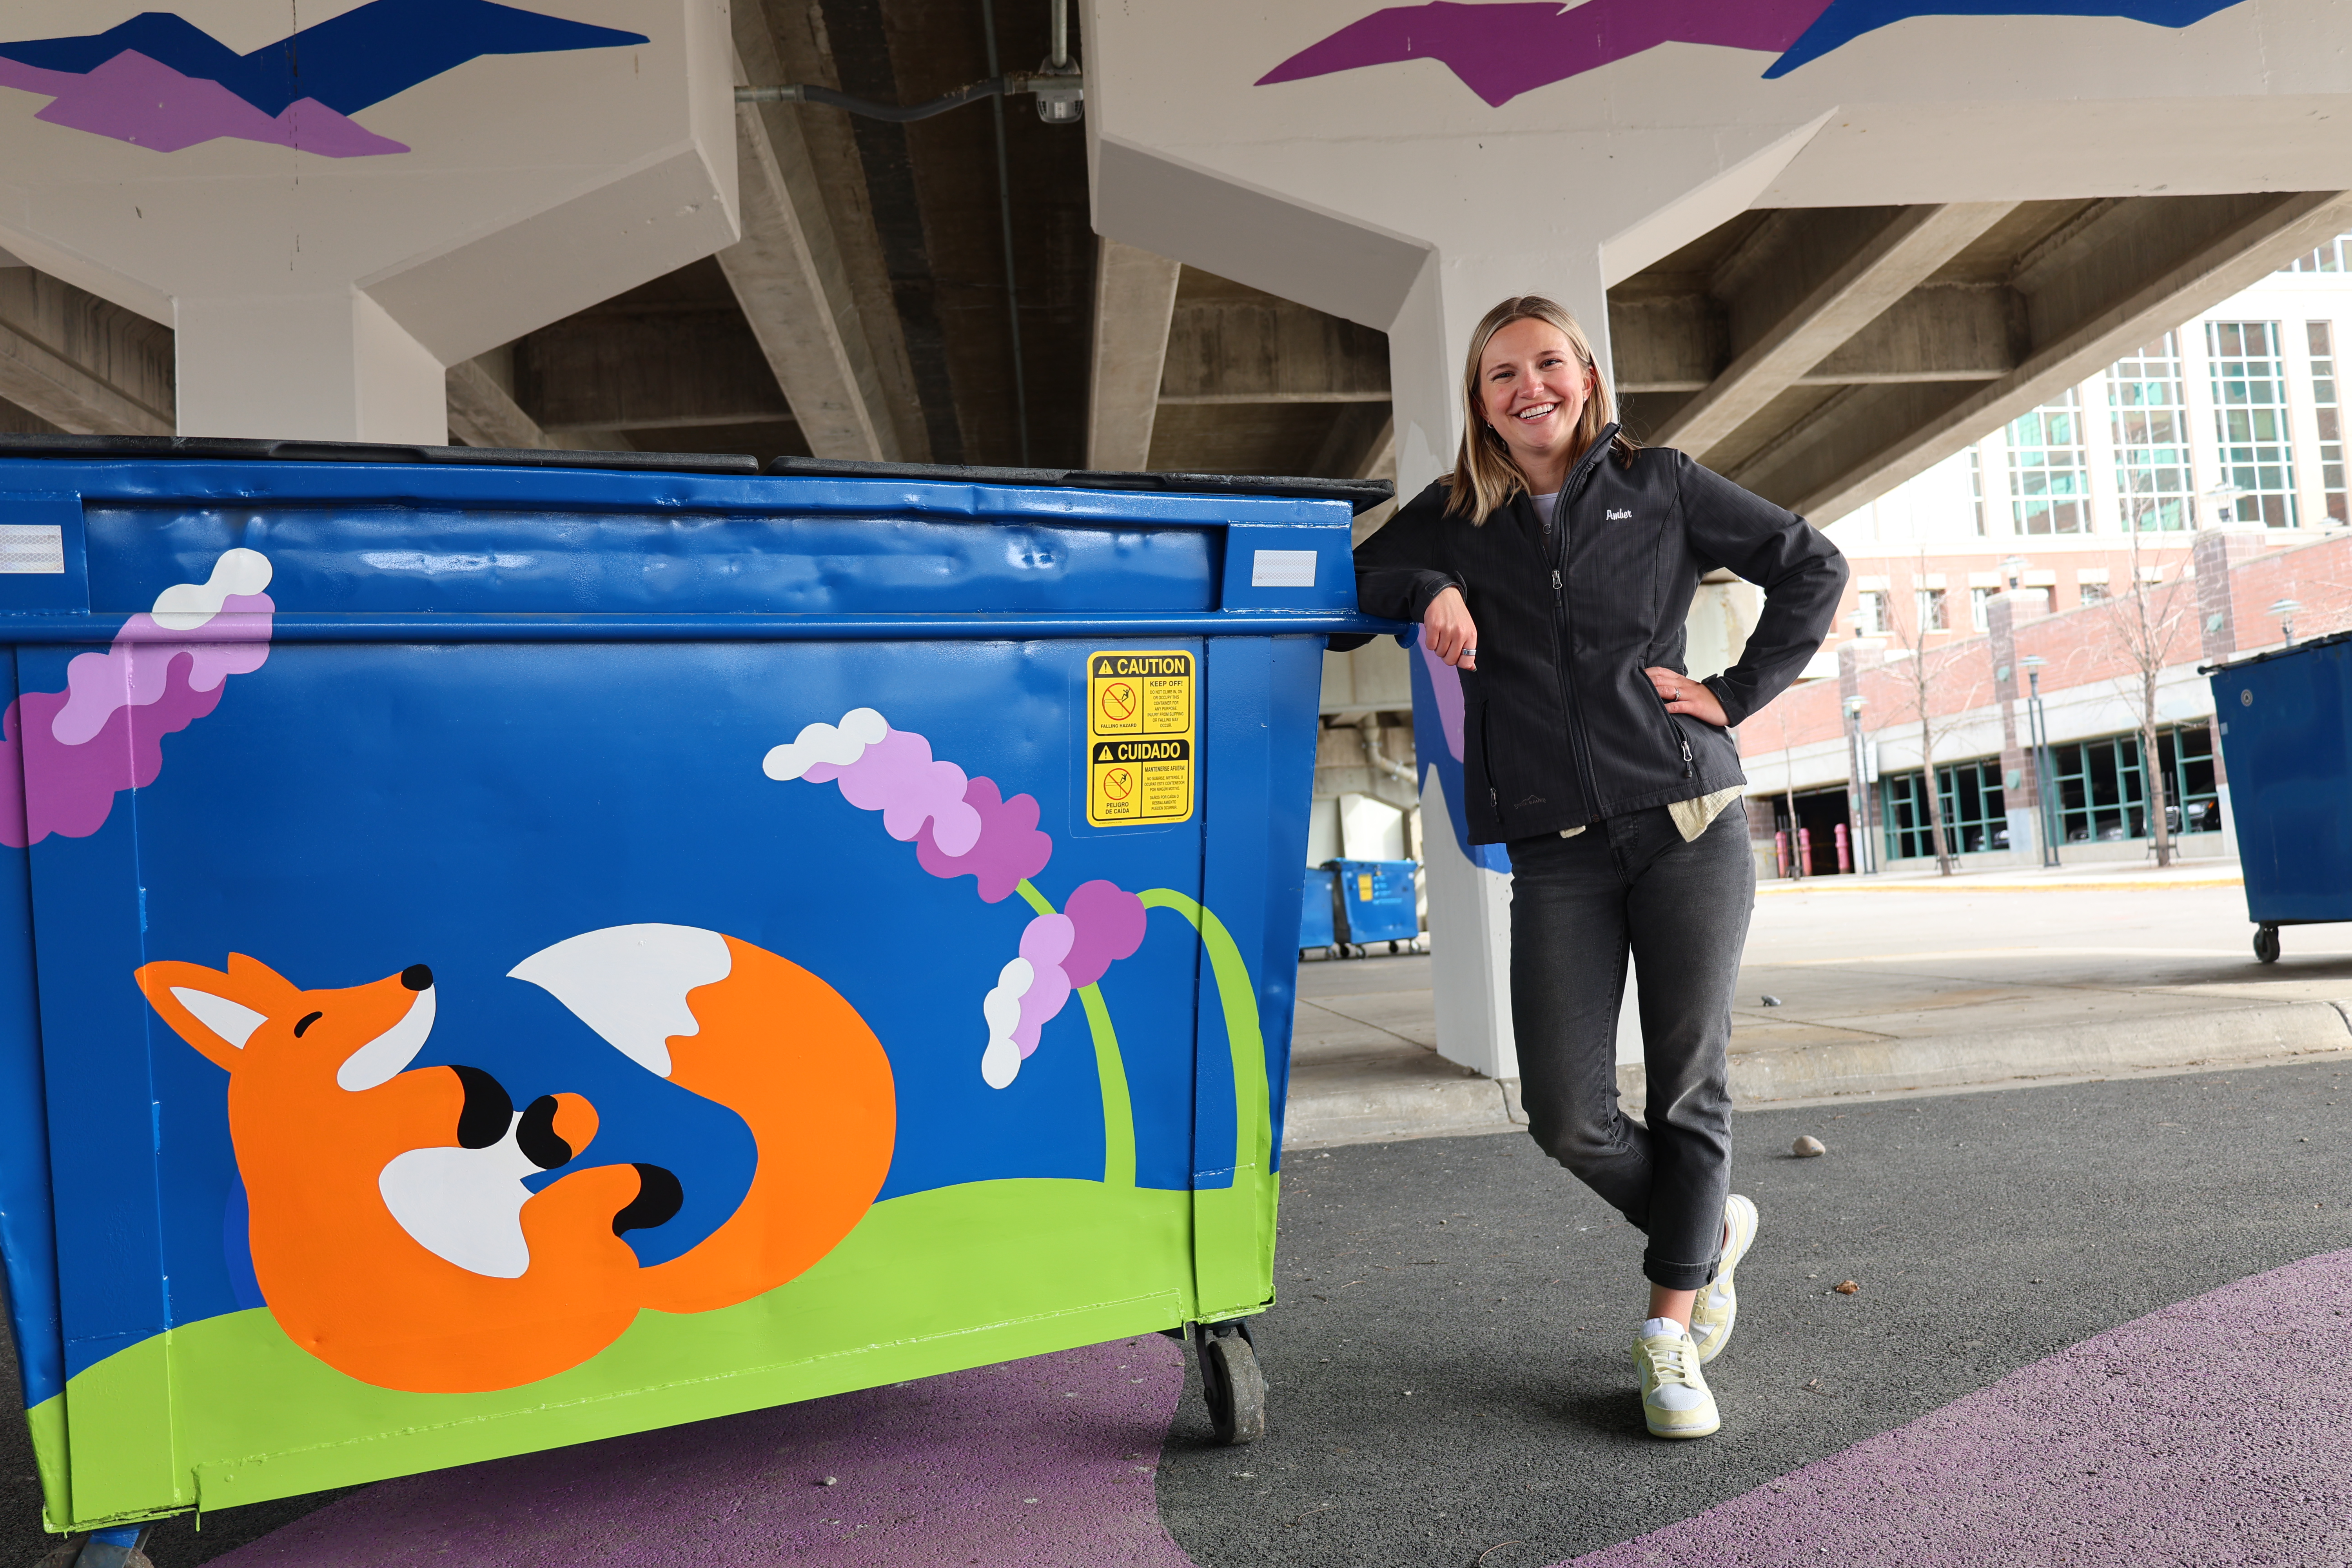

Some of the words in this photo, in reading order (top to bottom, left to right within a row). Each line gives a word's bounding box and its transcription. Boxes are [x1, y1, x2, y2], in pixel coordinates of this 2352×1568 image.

[1606, 508, 1632, 520] Amber
[1117, 658, 1184, 674] CAUTION
[1118, 742, 1180, 760] CUIDADO
